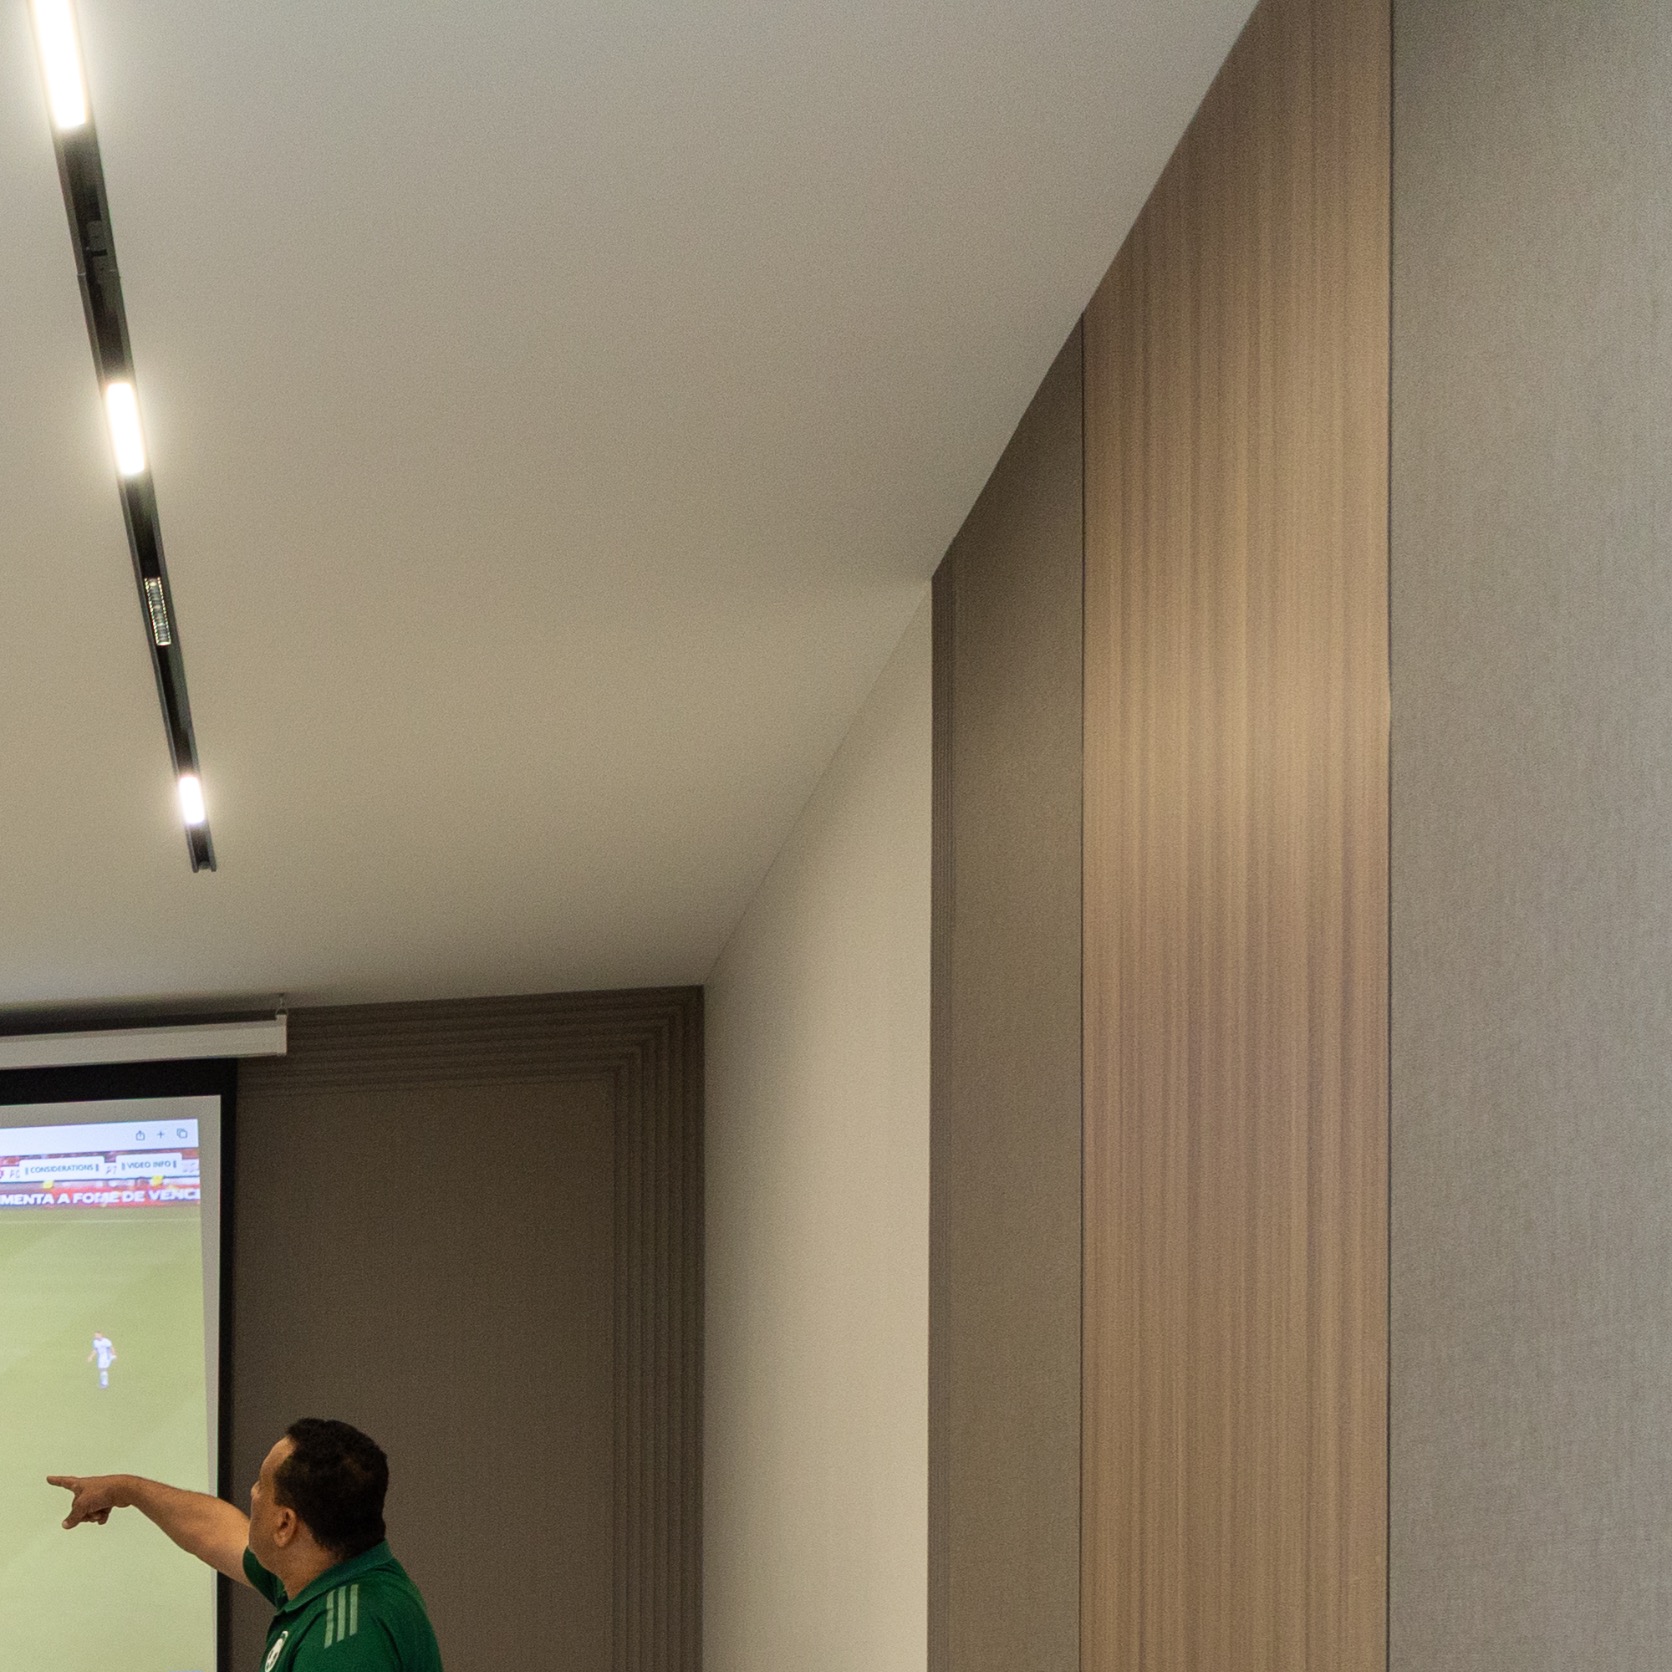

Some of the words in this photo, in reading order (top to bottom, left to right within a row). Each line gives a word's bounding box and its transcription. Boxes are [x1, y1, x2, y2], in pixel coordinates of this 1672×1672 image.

[30, 1164, 94, 1173] CONSIDERATIONS
[127, 1161, 151, 1169] VIDEO
[153, 1160, 171, 1168] INFO
[57, 1193, 70, 1204] A
[123, 1190, 145, 1202] DE
